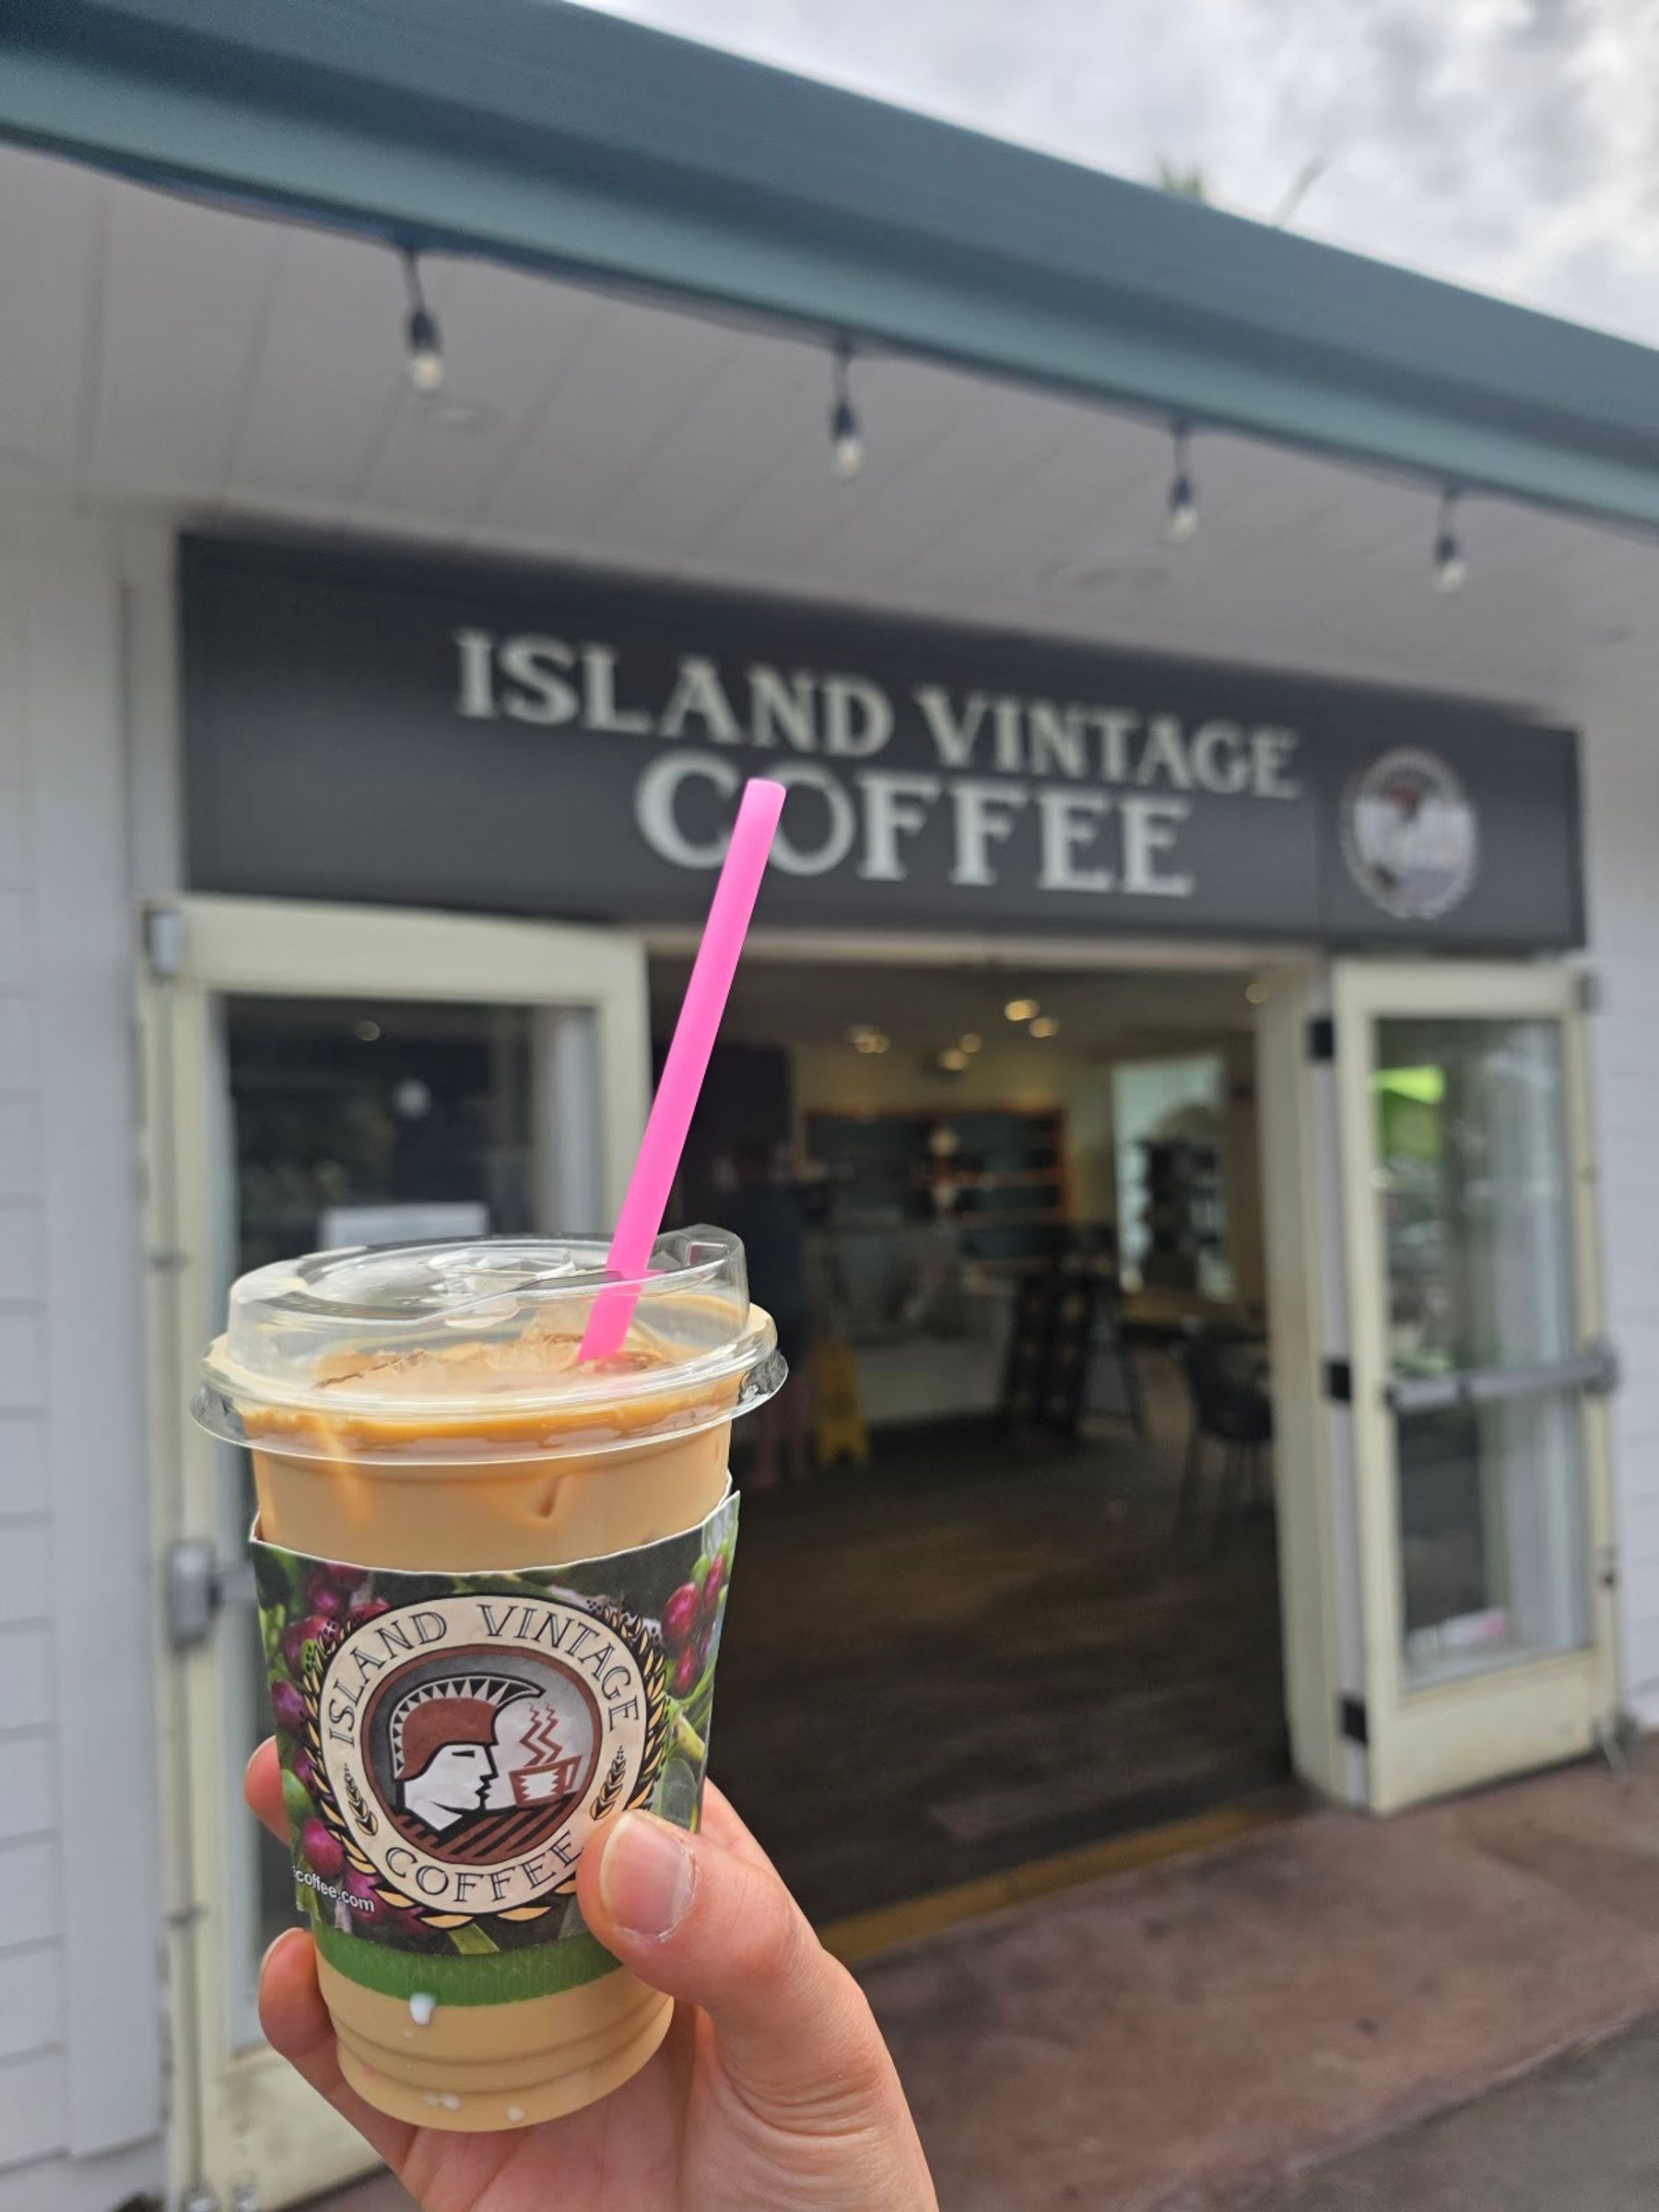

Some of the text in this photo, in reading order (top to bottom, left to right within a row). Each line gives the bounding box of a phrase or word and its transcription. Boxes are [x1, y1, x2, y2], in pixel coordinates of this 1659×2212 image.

[453, 628, 1302, 800] ISLAND VINTAGE
[634, 749, 1196, 899] COFFEE
[327, 1603, 641, 1748] ISLAND VINTAGE
[384, 1830, 584, 1902] COFFEE
